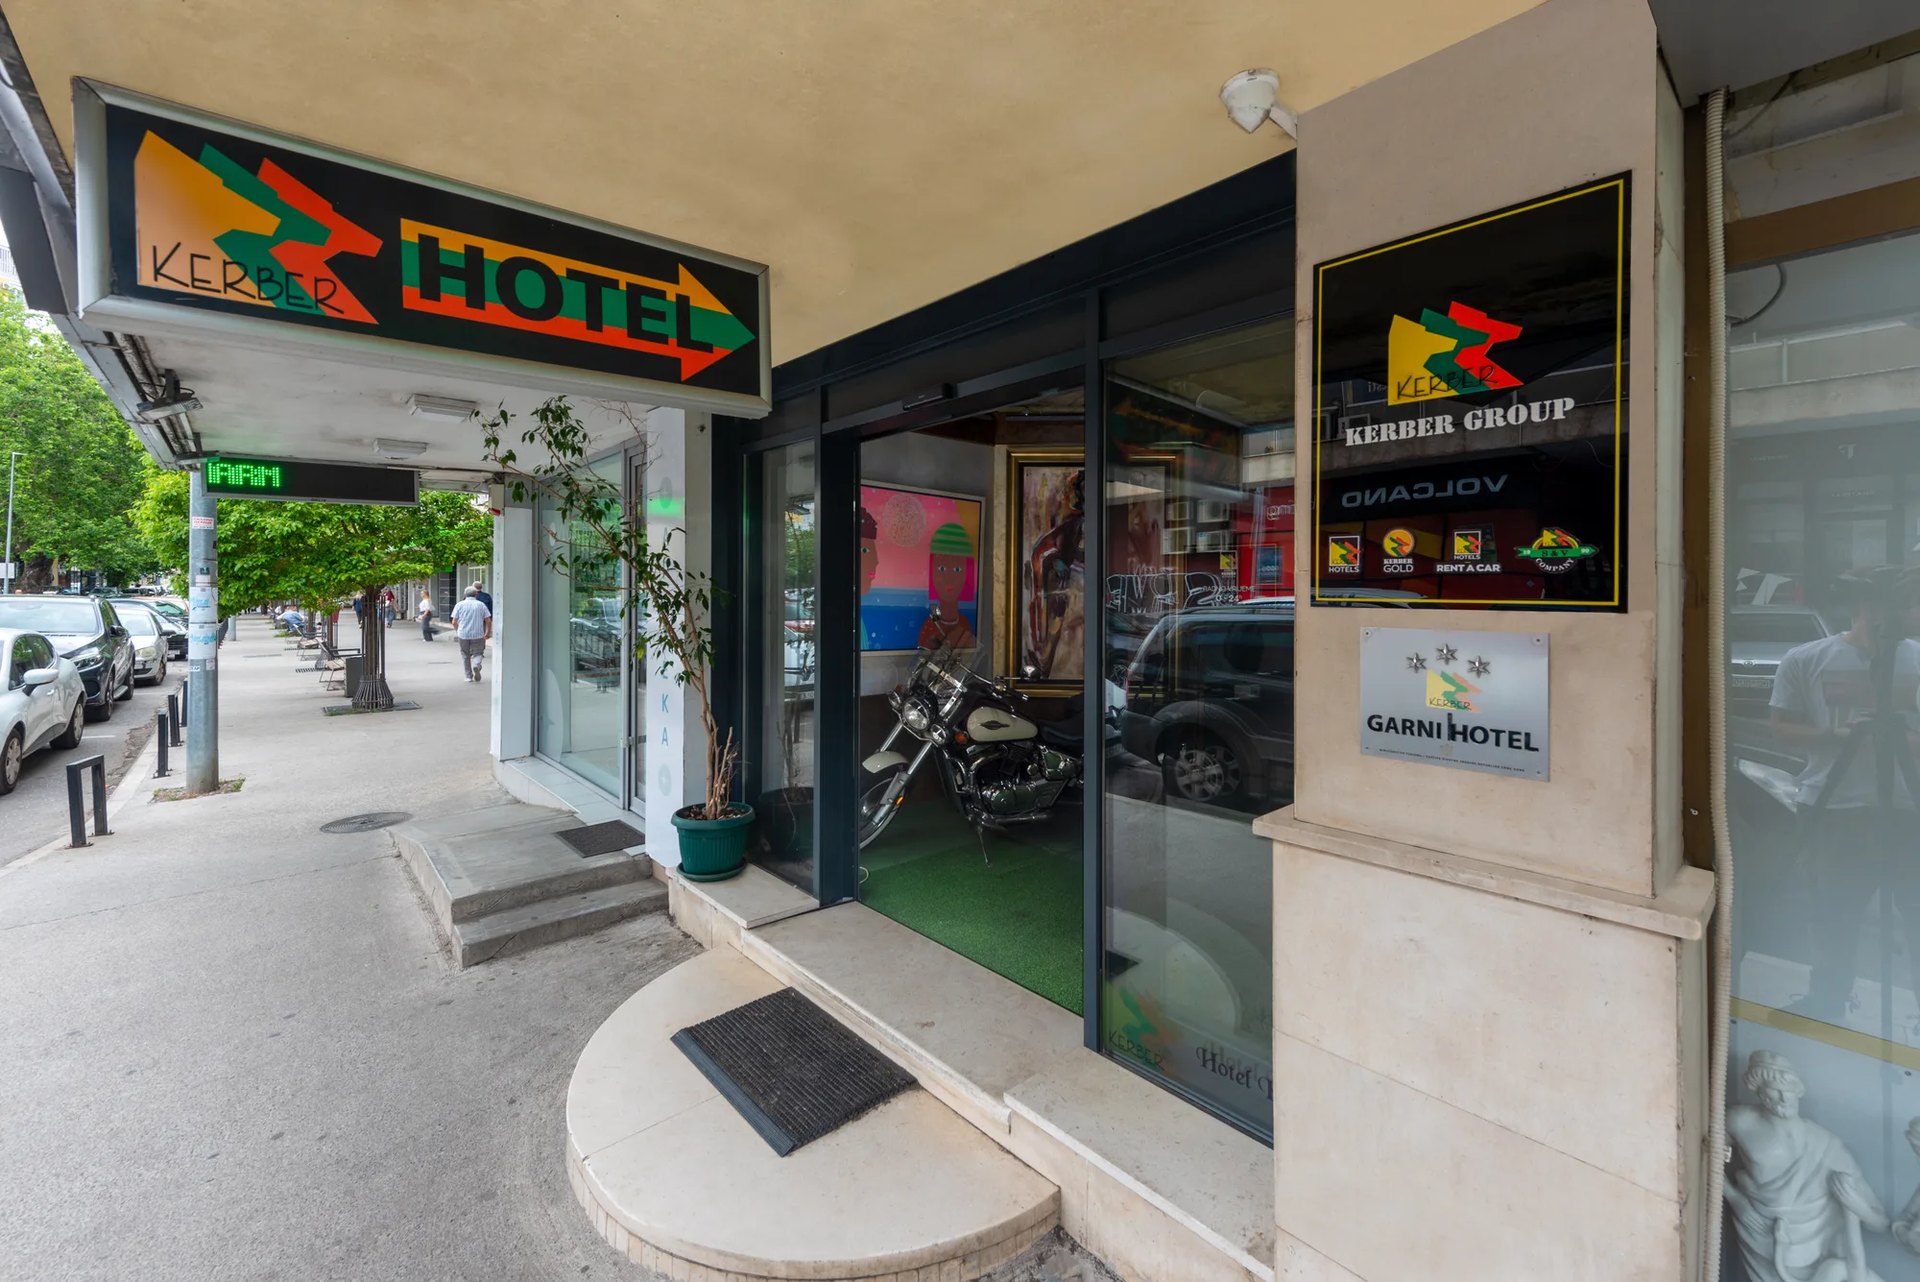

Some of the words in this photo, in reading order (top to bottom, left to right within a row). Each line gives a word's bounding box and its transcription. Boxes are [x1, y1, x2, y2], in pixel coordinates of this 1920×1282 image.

[152, 240, 345, 315] KERBER
[417, 233, 714, 354] HOTEL
[1396, 365, 1498, 400] KERBER
[1345, 415, 1455, 447] KERBER
[1463, 397, 1576, 433] GROUP
[1383, 564, 1414, 573] GOLD
[1436, 564, 1465, 572] RENT
[1466, 564, 1475, 572] A
[1476, 563, 1501, 572] CAR
[1535, 557, 1575, 572] COMPANY
[1429, 696, 1472, 711] KERBER
[1367, 713, 1442, 740] GARNI
[1449, 722, 1540, 752] HOTEL
[1195, 1045, 1253, 1089] Hotel
